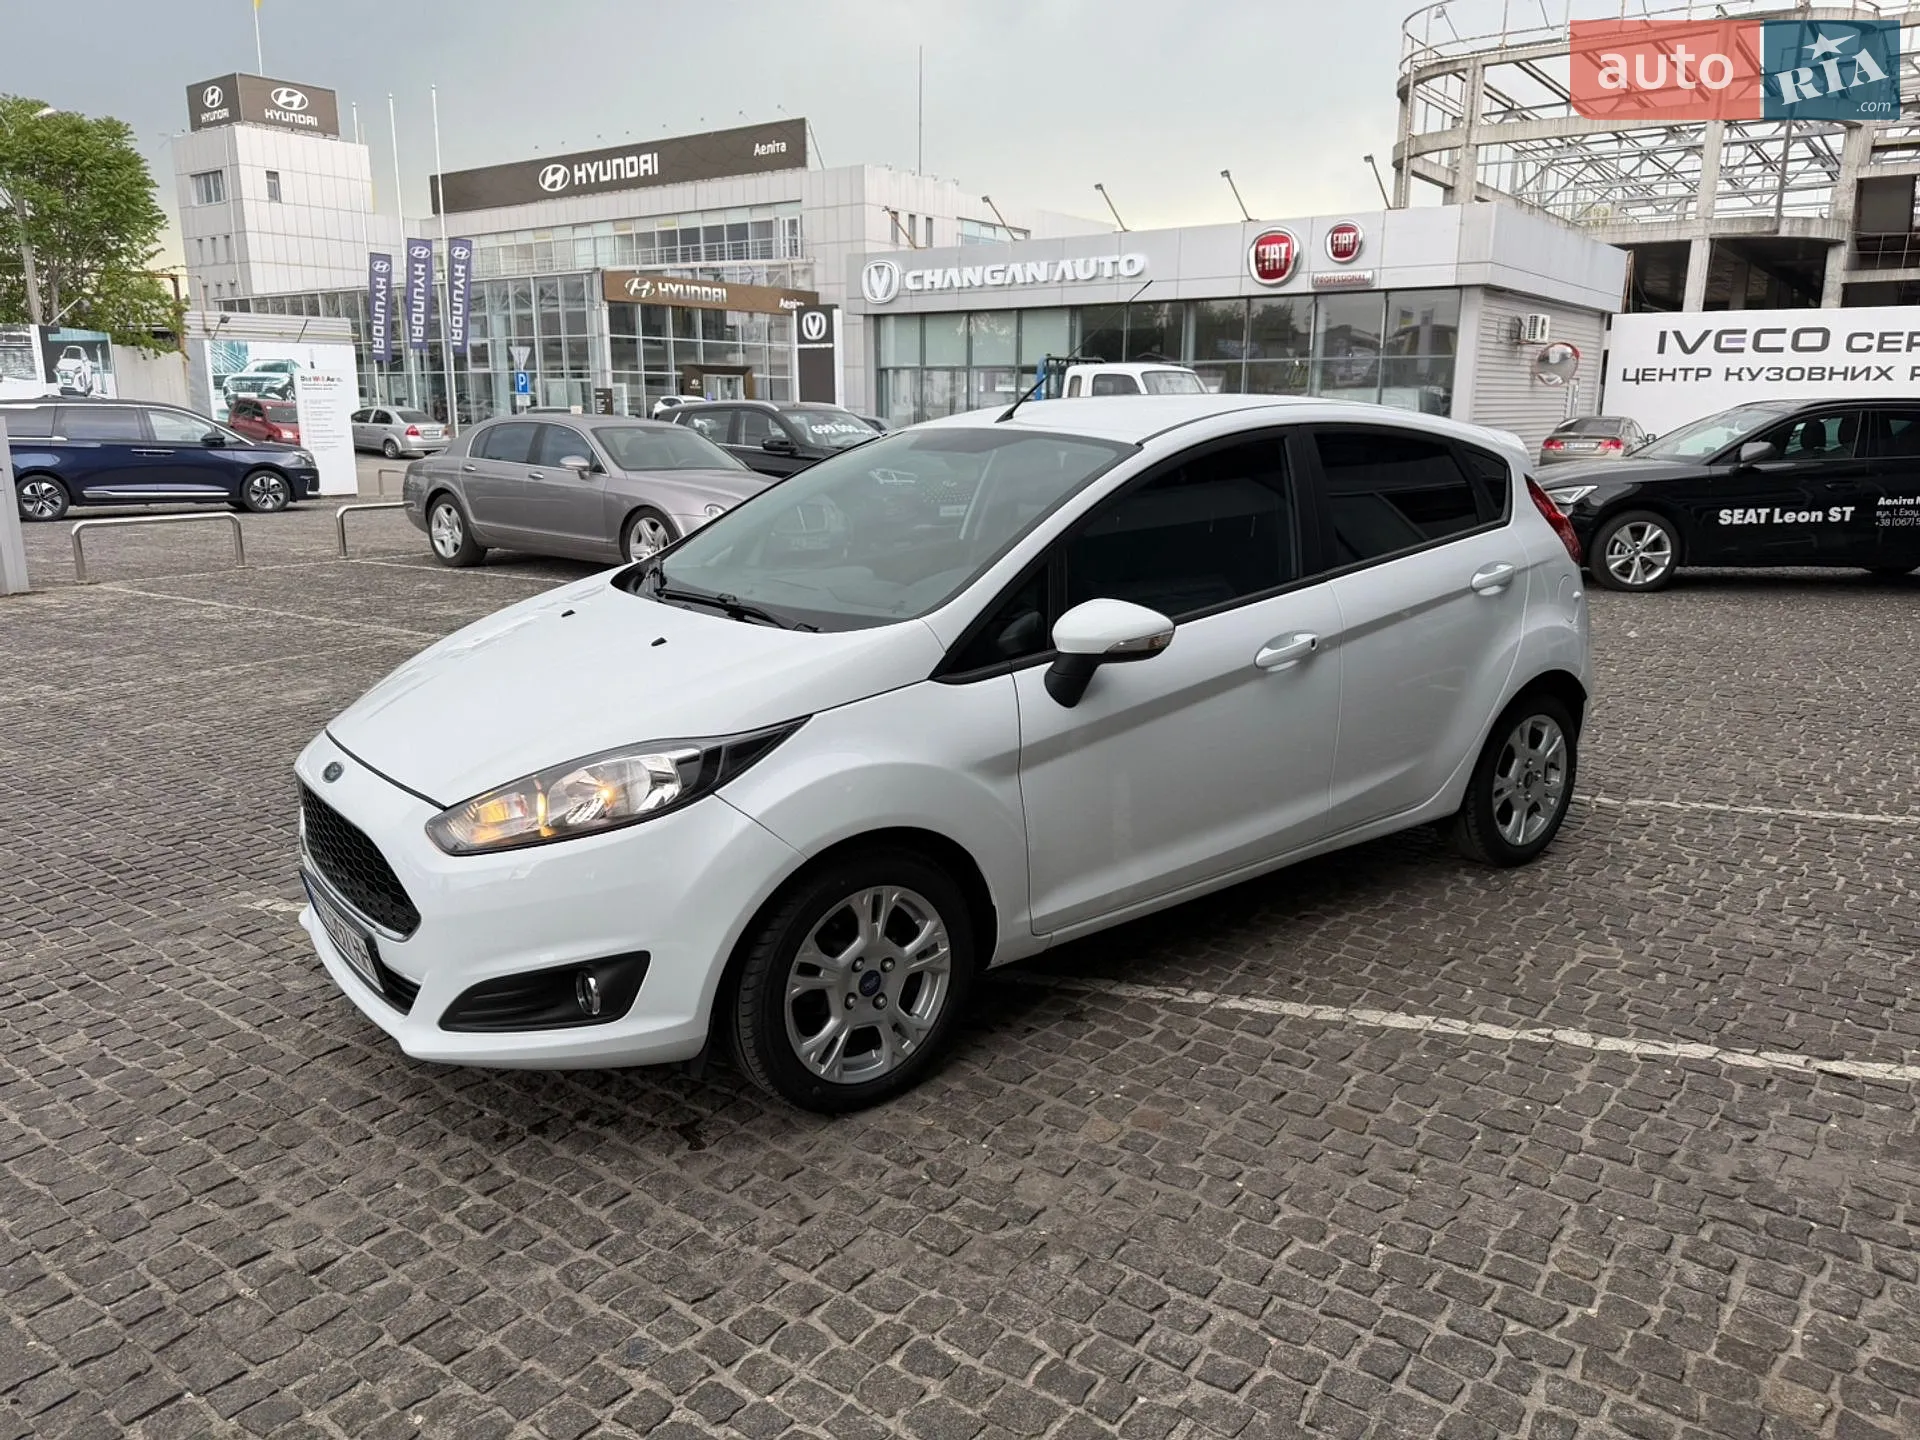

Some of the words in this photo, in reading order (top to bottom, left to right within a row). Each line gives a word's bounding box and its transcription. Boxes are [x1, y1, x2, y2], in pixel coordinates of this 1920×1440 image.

[201, 107, 230, 123] HYUNDAI
[264, 108, 318, 127] HYUNDAI
[753, 140, 787, 157] Аеліта
[573, 152, 659, 185] HYUNDAI
[1332, 231, 1357, 252] FIAT
[1257, 242, 1289, 271] FIAT
[905, 261, 1049, 291] CHANGAN
[1054, 253, 1147, 281] AUTO
[411, 263, 426, 343] HYUNDAI
[658, 281, 727, 303] HYUNDAI
[372, 277, 387, 354] HYUNDAI
[451, 264, 466, 346] HYUNDAI
[1656, 326, 1831, 355] IVECO
[1622, 367, 1712, 385] ЦЕНТР
[1724, 366, 1896, 382] КУЗОВНИХ
[1877, 496, 1914, 505] Аеліта
[1718, 508, 1770, 525] SEAT
[1773, 507, 1823, 523] Leon
[1827, 506, 1855, 522] ST
